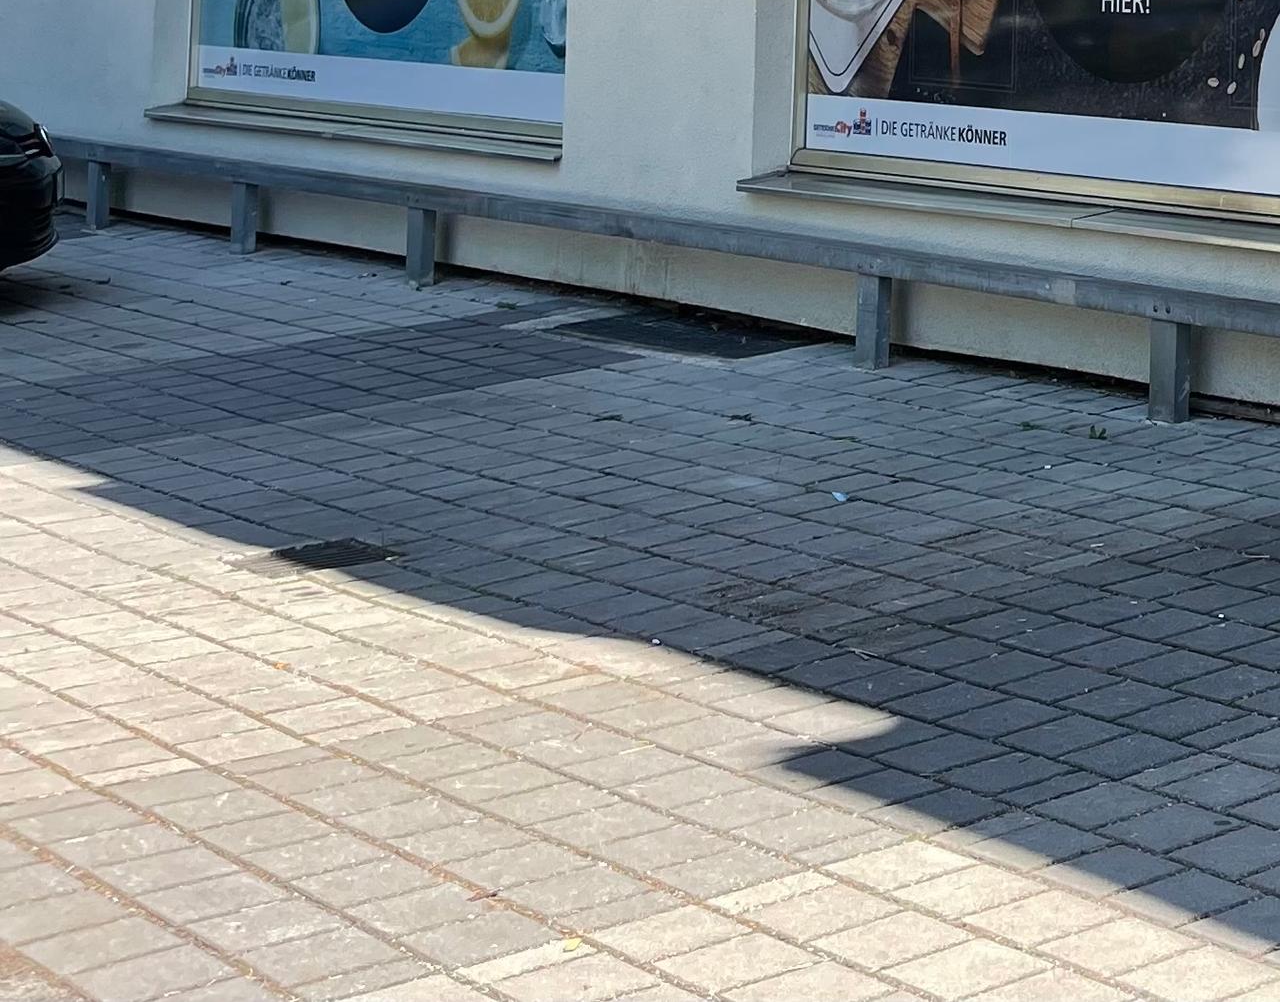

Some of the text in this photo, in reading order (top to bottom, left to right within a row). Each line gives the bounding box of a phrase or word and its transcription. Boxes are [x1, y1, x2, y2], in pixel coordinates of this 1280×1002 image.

[881, 119, 1007, 146] DIE GETRÄNKE KÖNNER
